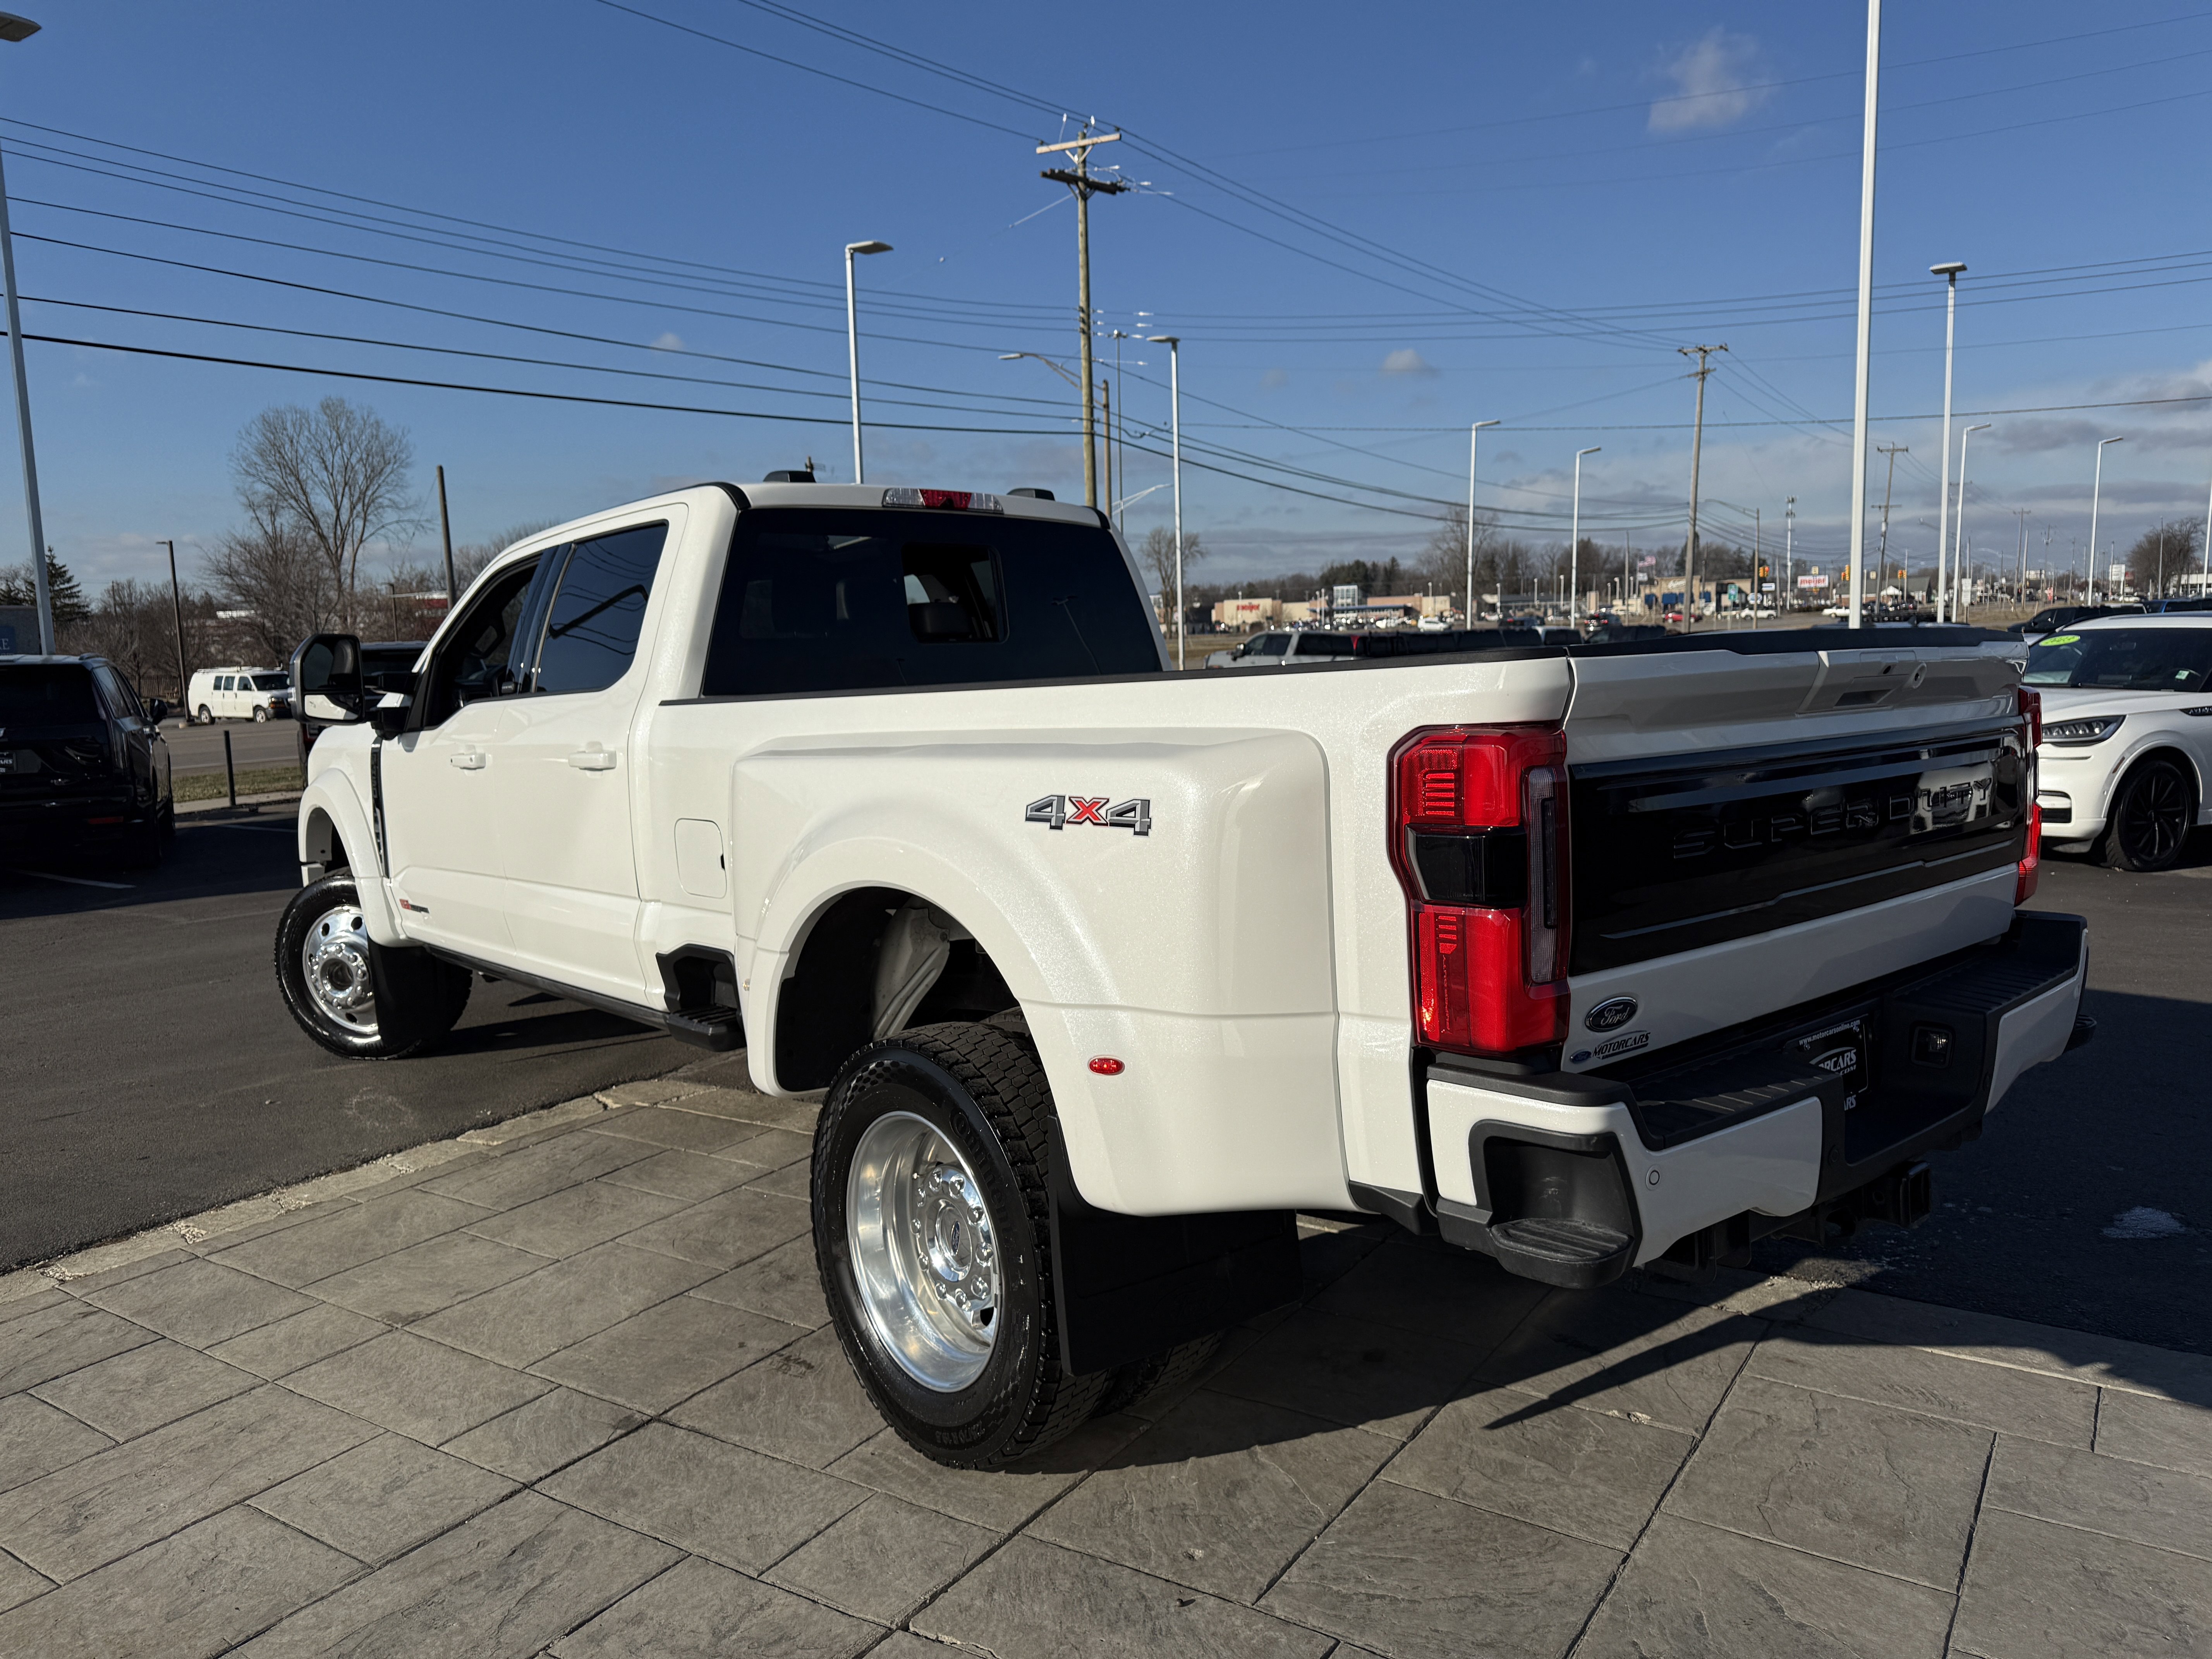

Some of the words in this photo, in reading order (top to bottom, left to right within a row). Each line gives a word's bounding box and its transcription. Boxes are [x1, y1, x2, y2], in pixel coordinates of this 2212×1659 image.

[1800, 577, 1825, 587] meijer
[1674, 799, 1880, 859] SUPER
[1889, 778, 1992, 821] DUTY
[1601, 1005, 1630, 1026] Ford
[1592, 1032, 1651, 1057] MOTORCARS
[1799, 1019, 1860, 1046] www.motorcarsonline.com
